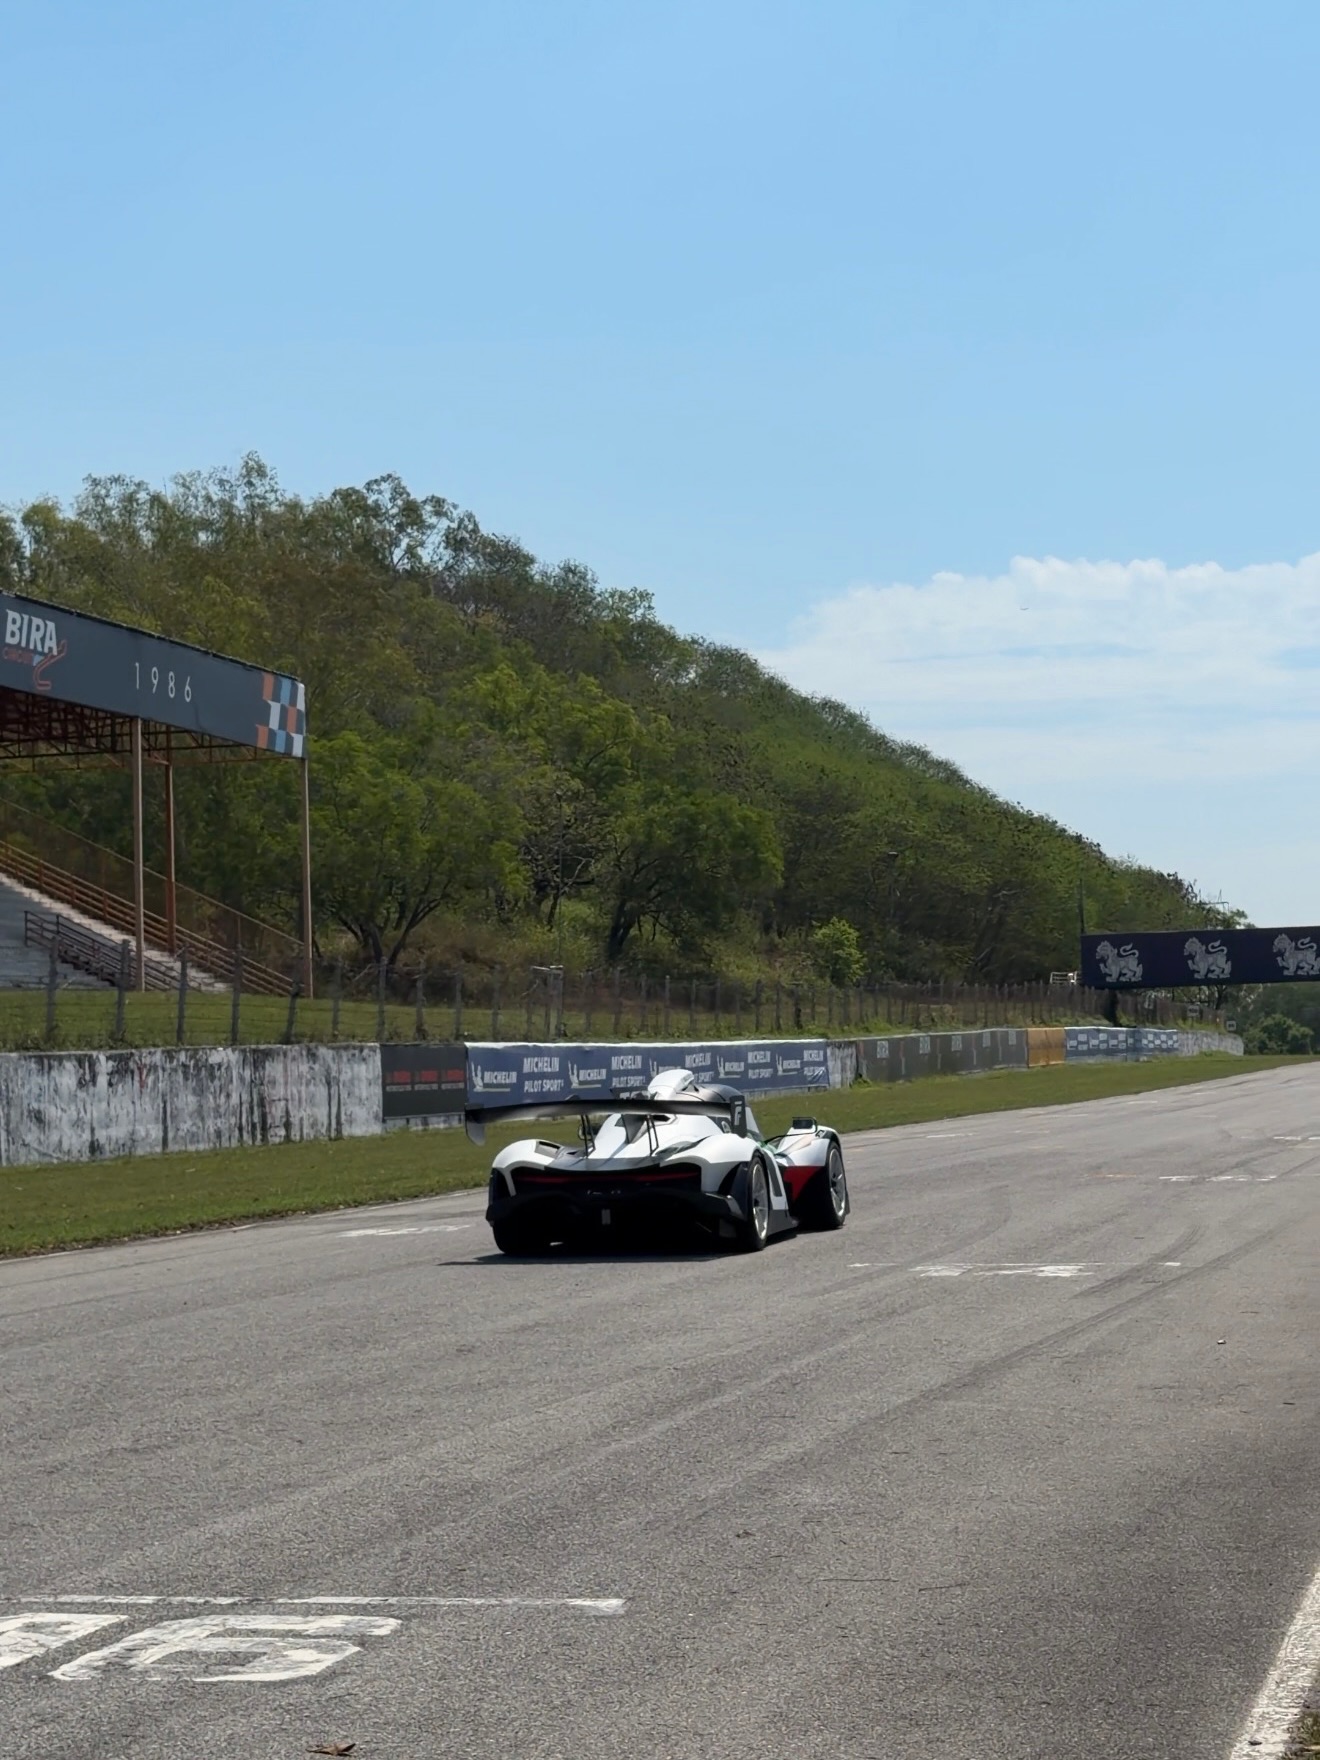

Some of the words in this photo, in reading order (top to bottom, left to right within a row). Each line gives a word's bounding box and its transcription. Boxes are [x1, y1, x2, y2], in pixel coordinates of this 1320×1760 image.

[5, 608, 58, 656] BIRA
[135, 662, 192, 702] 1986
[522, 1057, 560, 1073] MICHELIN
[611, 1055, 642, 1071] MICHELIN
[484, 1071, 518, 1084] MICHELIN
[579, 1069, 607, 1081] MICHELIN
[524, 1080, 542, 1093] PILOT
